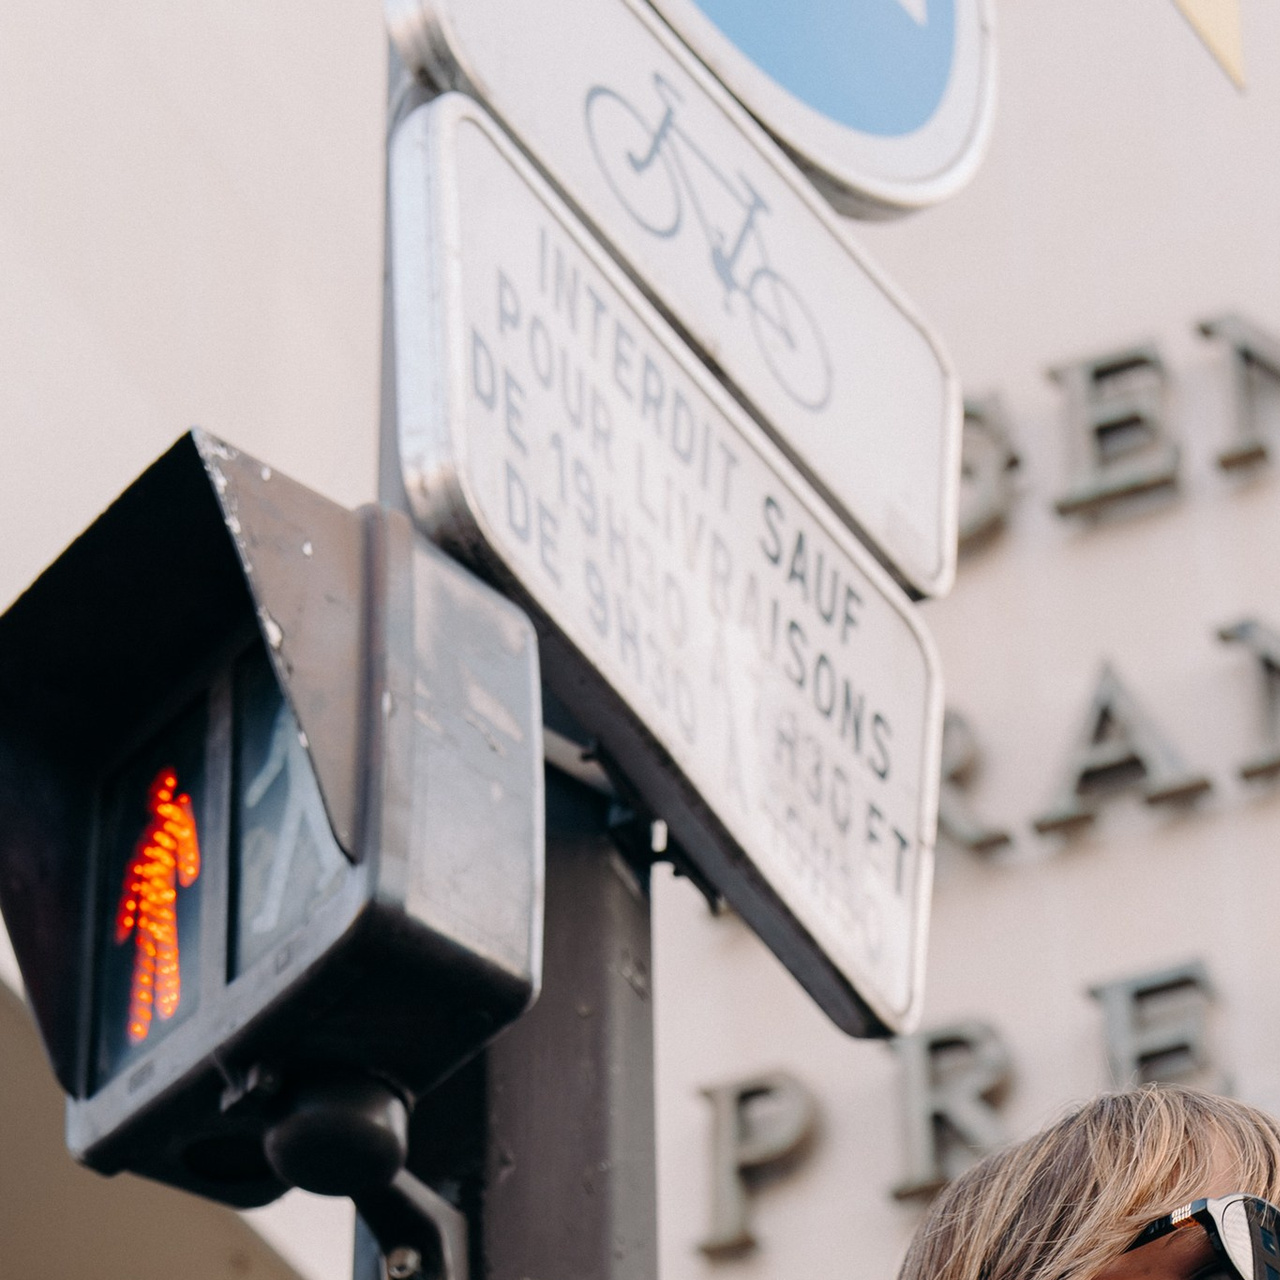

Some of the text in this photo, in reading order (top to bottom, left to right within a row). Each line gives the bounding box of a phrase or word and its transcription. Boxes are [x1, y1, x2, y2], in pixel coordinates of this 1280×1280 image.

[472, 328, 527, 458] DE
[497, 269, 893, 784] POUR LIVRAISONS
[505, 459, 562, 586] DE
[539, 226, 865, 646] INTERDIT SAUF
